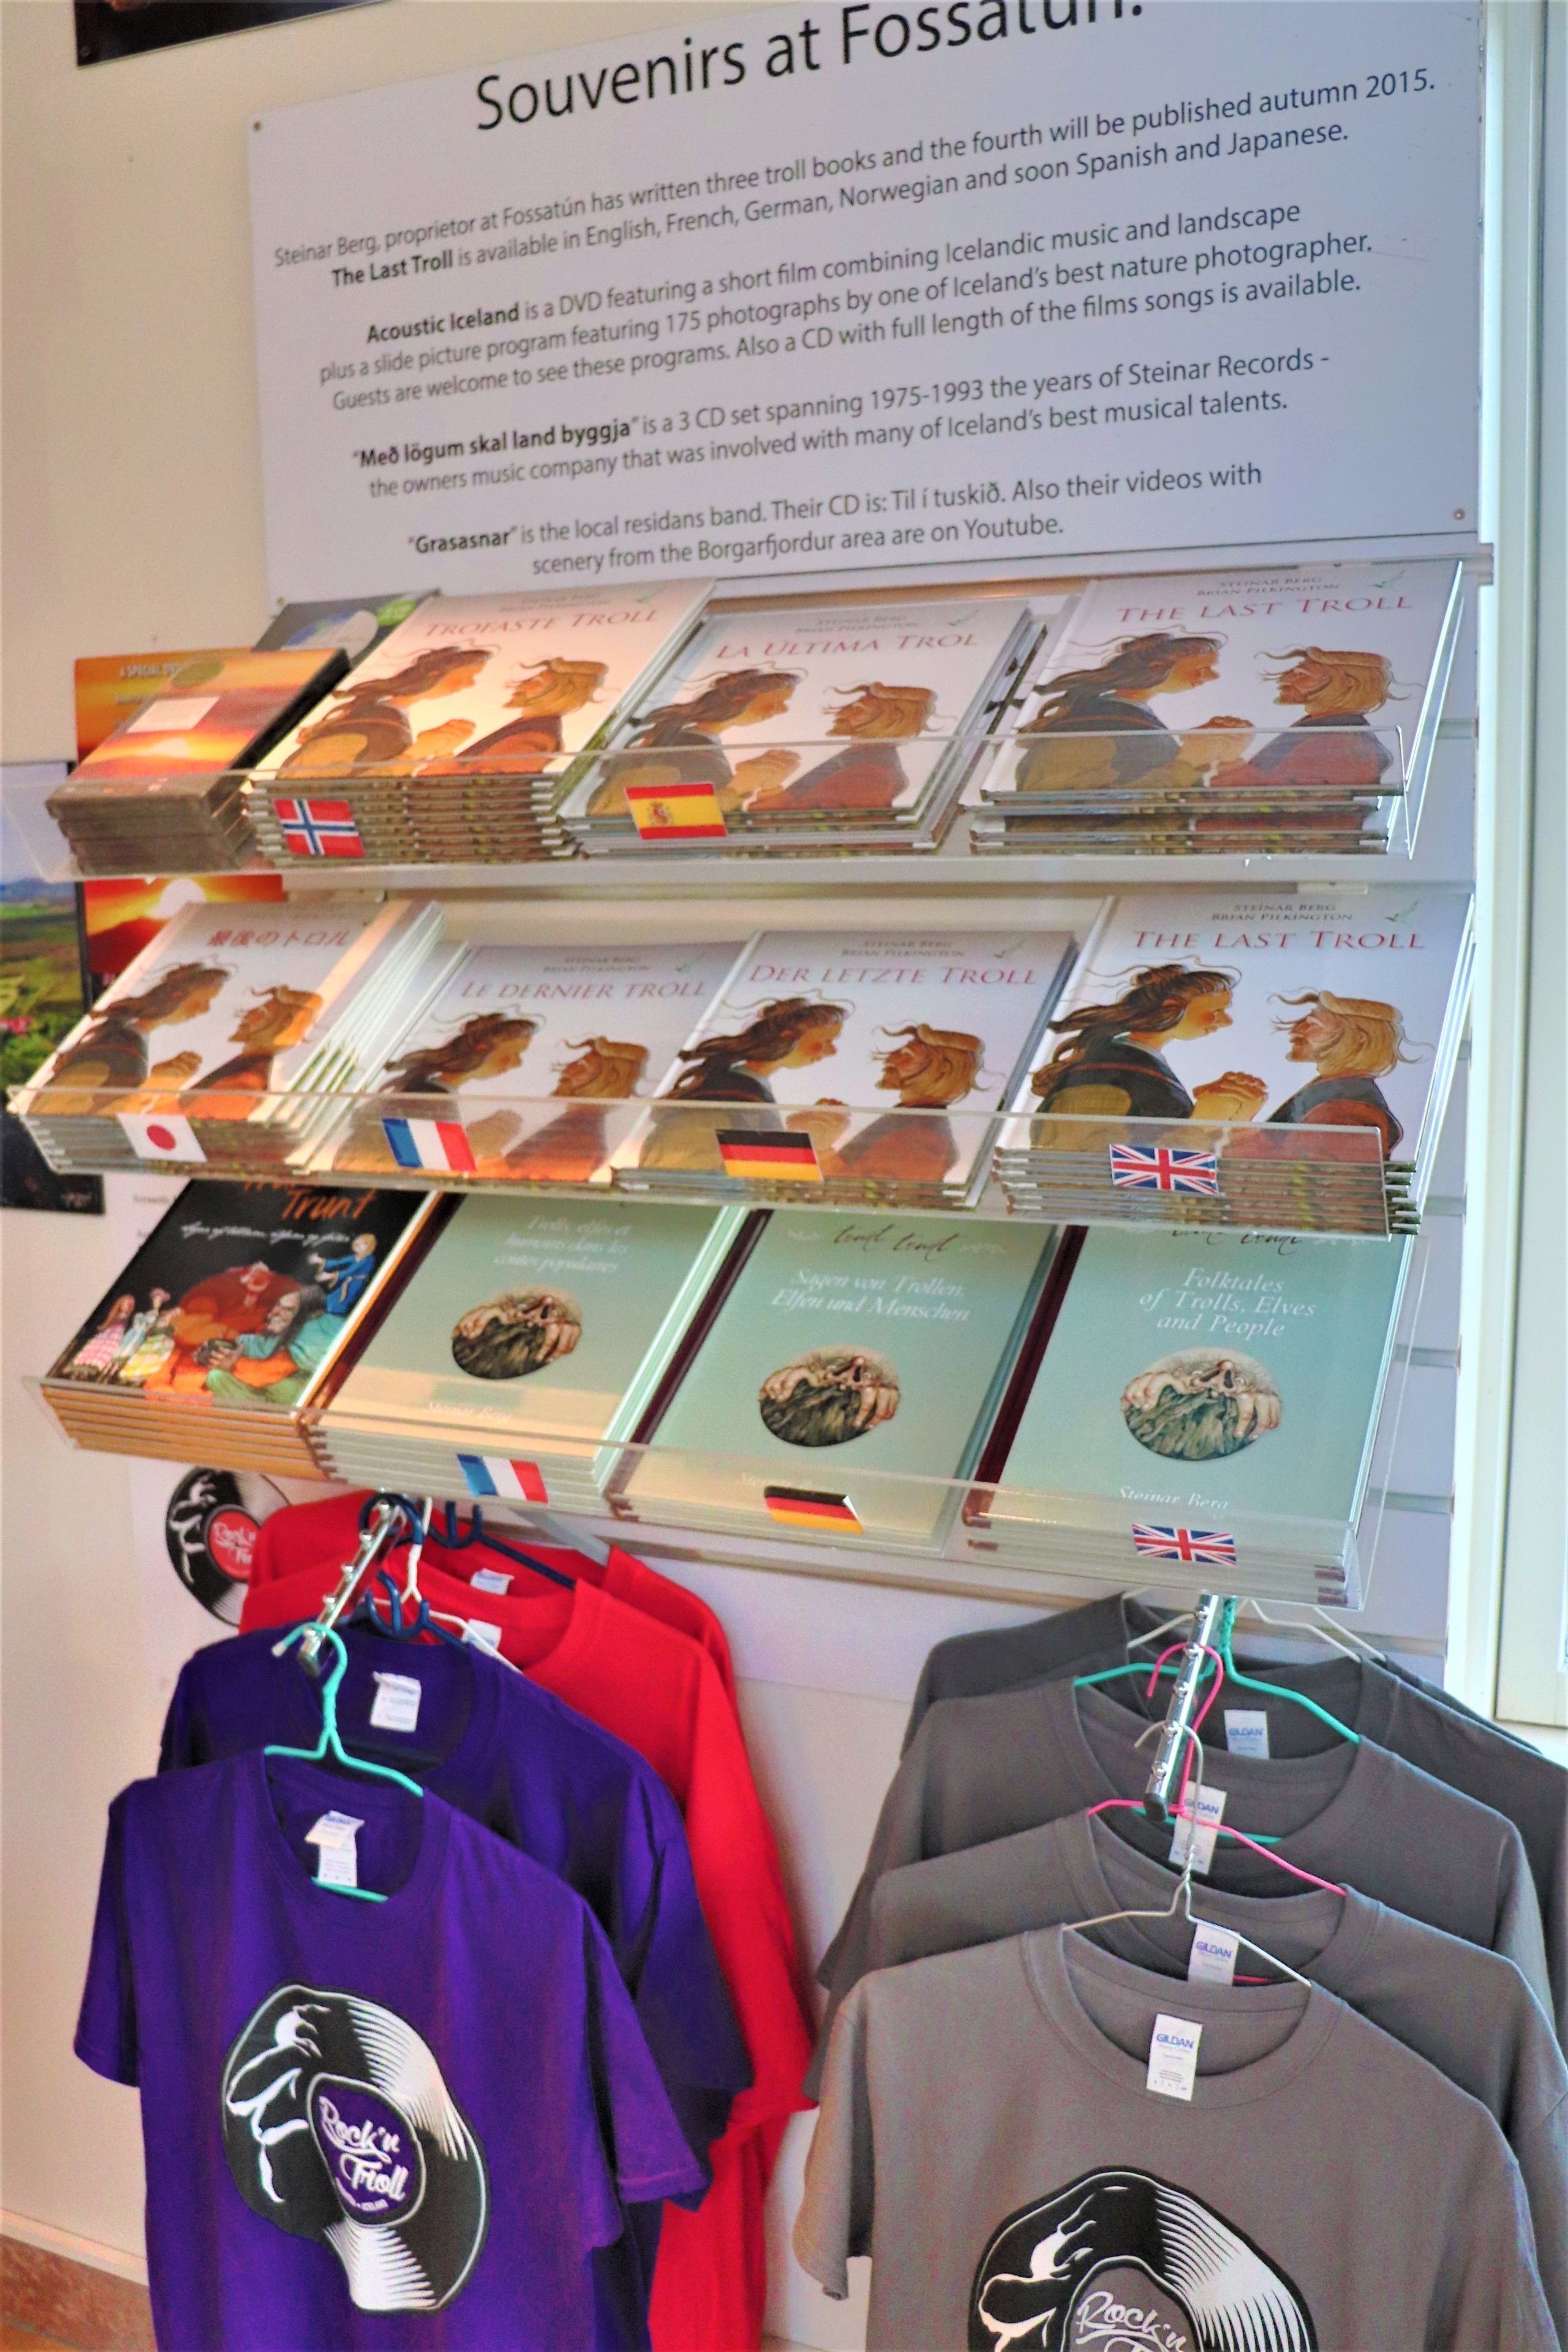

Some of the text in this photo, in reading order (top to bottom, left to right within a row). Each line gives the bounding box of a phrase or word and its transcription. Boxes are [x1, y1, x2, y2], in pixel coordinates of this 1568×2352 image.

[478, 37, 747, 130] Souvenirs
[766, 18, 822, 77] at
[274, 242, 333, 269] Steinar
[336, 235, 381, 257] Berg,
[384, 217, 477, 252] proprietor
[480, 211, 499, 232] at
[590, 191, 625, 213] has
[628, 180, 701, 206] written
[704, 170, 761, 195] three
[764, 157, 807, 186] troll
[812, 148, 878, 179] books
[881, 138, 924, 168] and
[929, 135, 967, 161] the
[971, 123, 1043, 154] fourth
[1048, 114, 1089, 143] will
[1095, 112, 1126, 137] be
[1131, 91, 1253, 138] published
[1258, 82, 1359, 115] autumn
[1365, 66, 1436, 100] 2015.
[330, 123, 1349, 288] The Last Troll is available in English, French, German, Norwegian and soon Spanish and Japanese.
[365, 203, 1302, 345] Acoustic Iceland is a DVD featuring a short film combining Icelandic music and landscape
[319, 360, 356, 388] plus
[359, 360, 369, 377] a
[373, 351, 414, 375] slide
[418, 344, 482, 372] picture
[486, 332, 567, 363] program
[570, 318, 660, 346] featuring
[666, 309, 701, 334] 175
[706, 293, 841, 334] photographs
[846, 288, 873, 315] by
[877, 285, 920, 307] one
[924, 276, 949, 302] of
[1055, 260, 1105, 287] best
[1110, 254, 1188, 280] nature
[1194, 230, 1373, 276] photographer.
[521, 524, 535, 545] is
[538, 521, 571, 543] the
[574, 514, 619, 539] local
[624, 508, 706, 535] residans
[709, 500, 767, 527] band.
[769, 497, 824, 521] Their
[827, 492, 861, 517] CD
[865, 492, 888, 514] is:
[889, 487, 916, 511] Til
[1011, 477, 1061, 502] Also
[1065, 472, 1121, 499] their
[1125, 467, 1204, 494] videos
[1208, 461, 1262, 488] with
[532, 513, 1065, 576] scenery from the Borgarfjordur area are on Youtube.
[571, 609, 658, 628] TROLL
[1117, 596, 1412, 623] THE LAST TROLL
[1133, 930, 1424, 949] THE LAST TROLL
[940, 965, 1038, 986] TROLL
[625, 981, 706, 998] TROLL
[1182, 1266, 1286, 1293] Folktales
[869, 1295, 971, 1321] Menschen
[1139, 1287, 1170, 1313] of
[1254, 1295, 1317, 1317] Elves
[1156, 1313, 1286, 1341] and People
[1228, 1727, 1264, 1737] GILDAN
[1195, 1940, 1232, 1959] GILDAN
[1156, 2033, 1194, 2049] GILDAN
[339, 2152, 410, 2201] Troll
